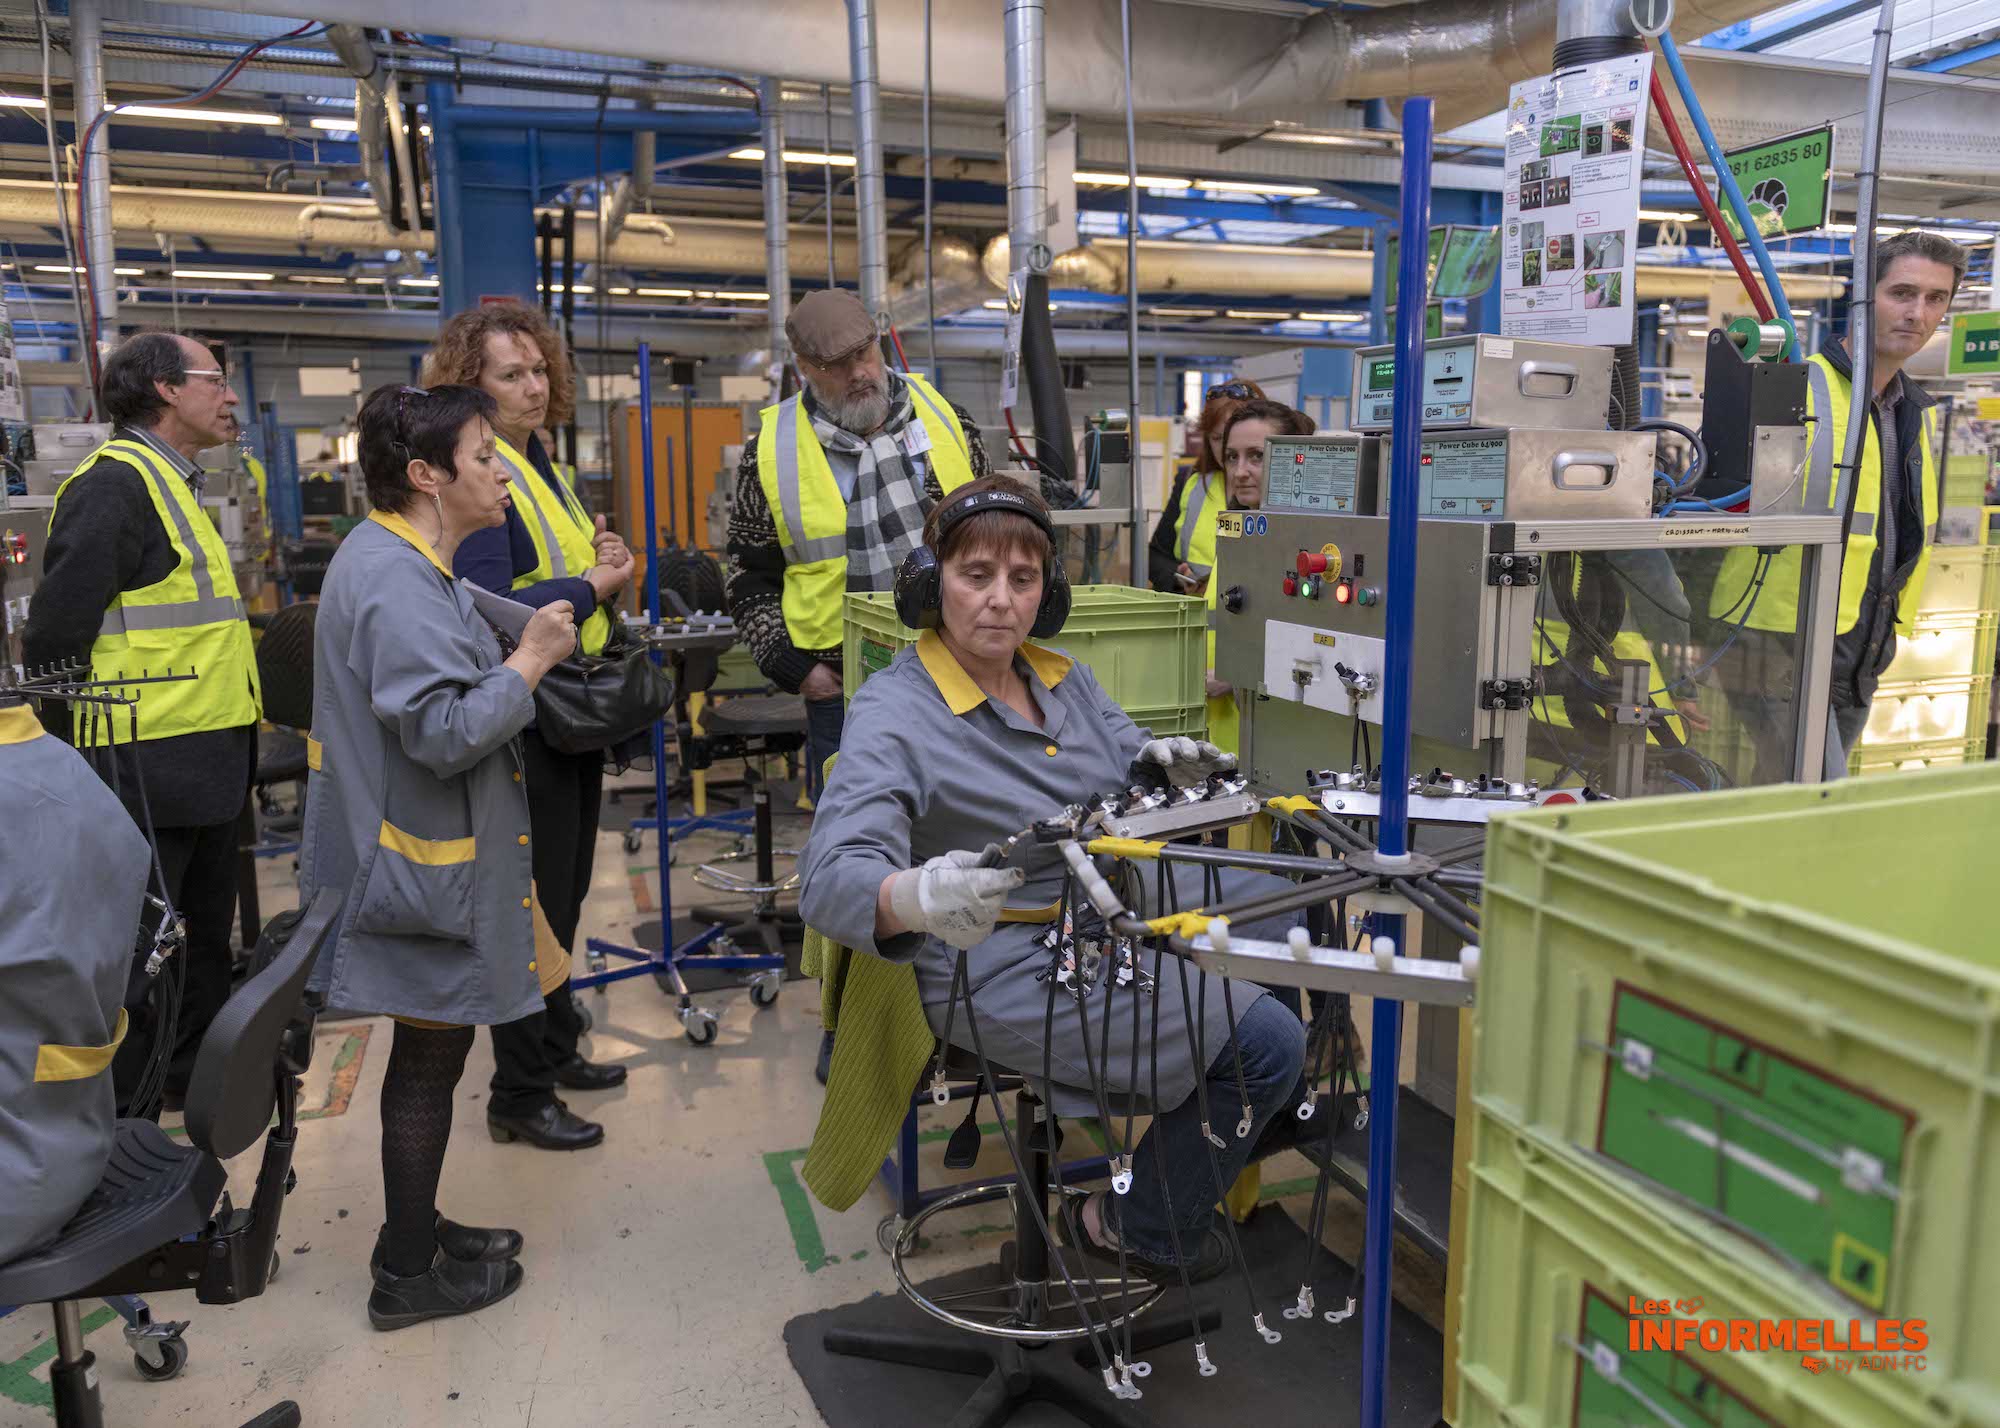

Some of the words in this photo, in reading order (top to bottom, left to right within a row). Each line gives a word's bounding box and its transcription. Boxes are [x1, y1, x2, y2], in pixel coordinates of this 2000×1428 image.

[1754, 148, 1798, 171] 62835
[1803, 142, 1822, 159] 80
[1461, 441, 1479, 449] Cube
[1480, 440, 1503, 448] 64/900
[1233, 522, 1241, 531] 12
